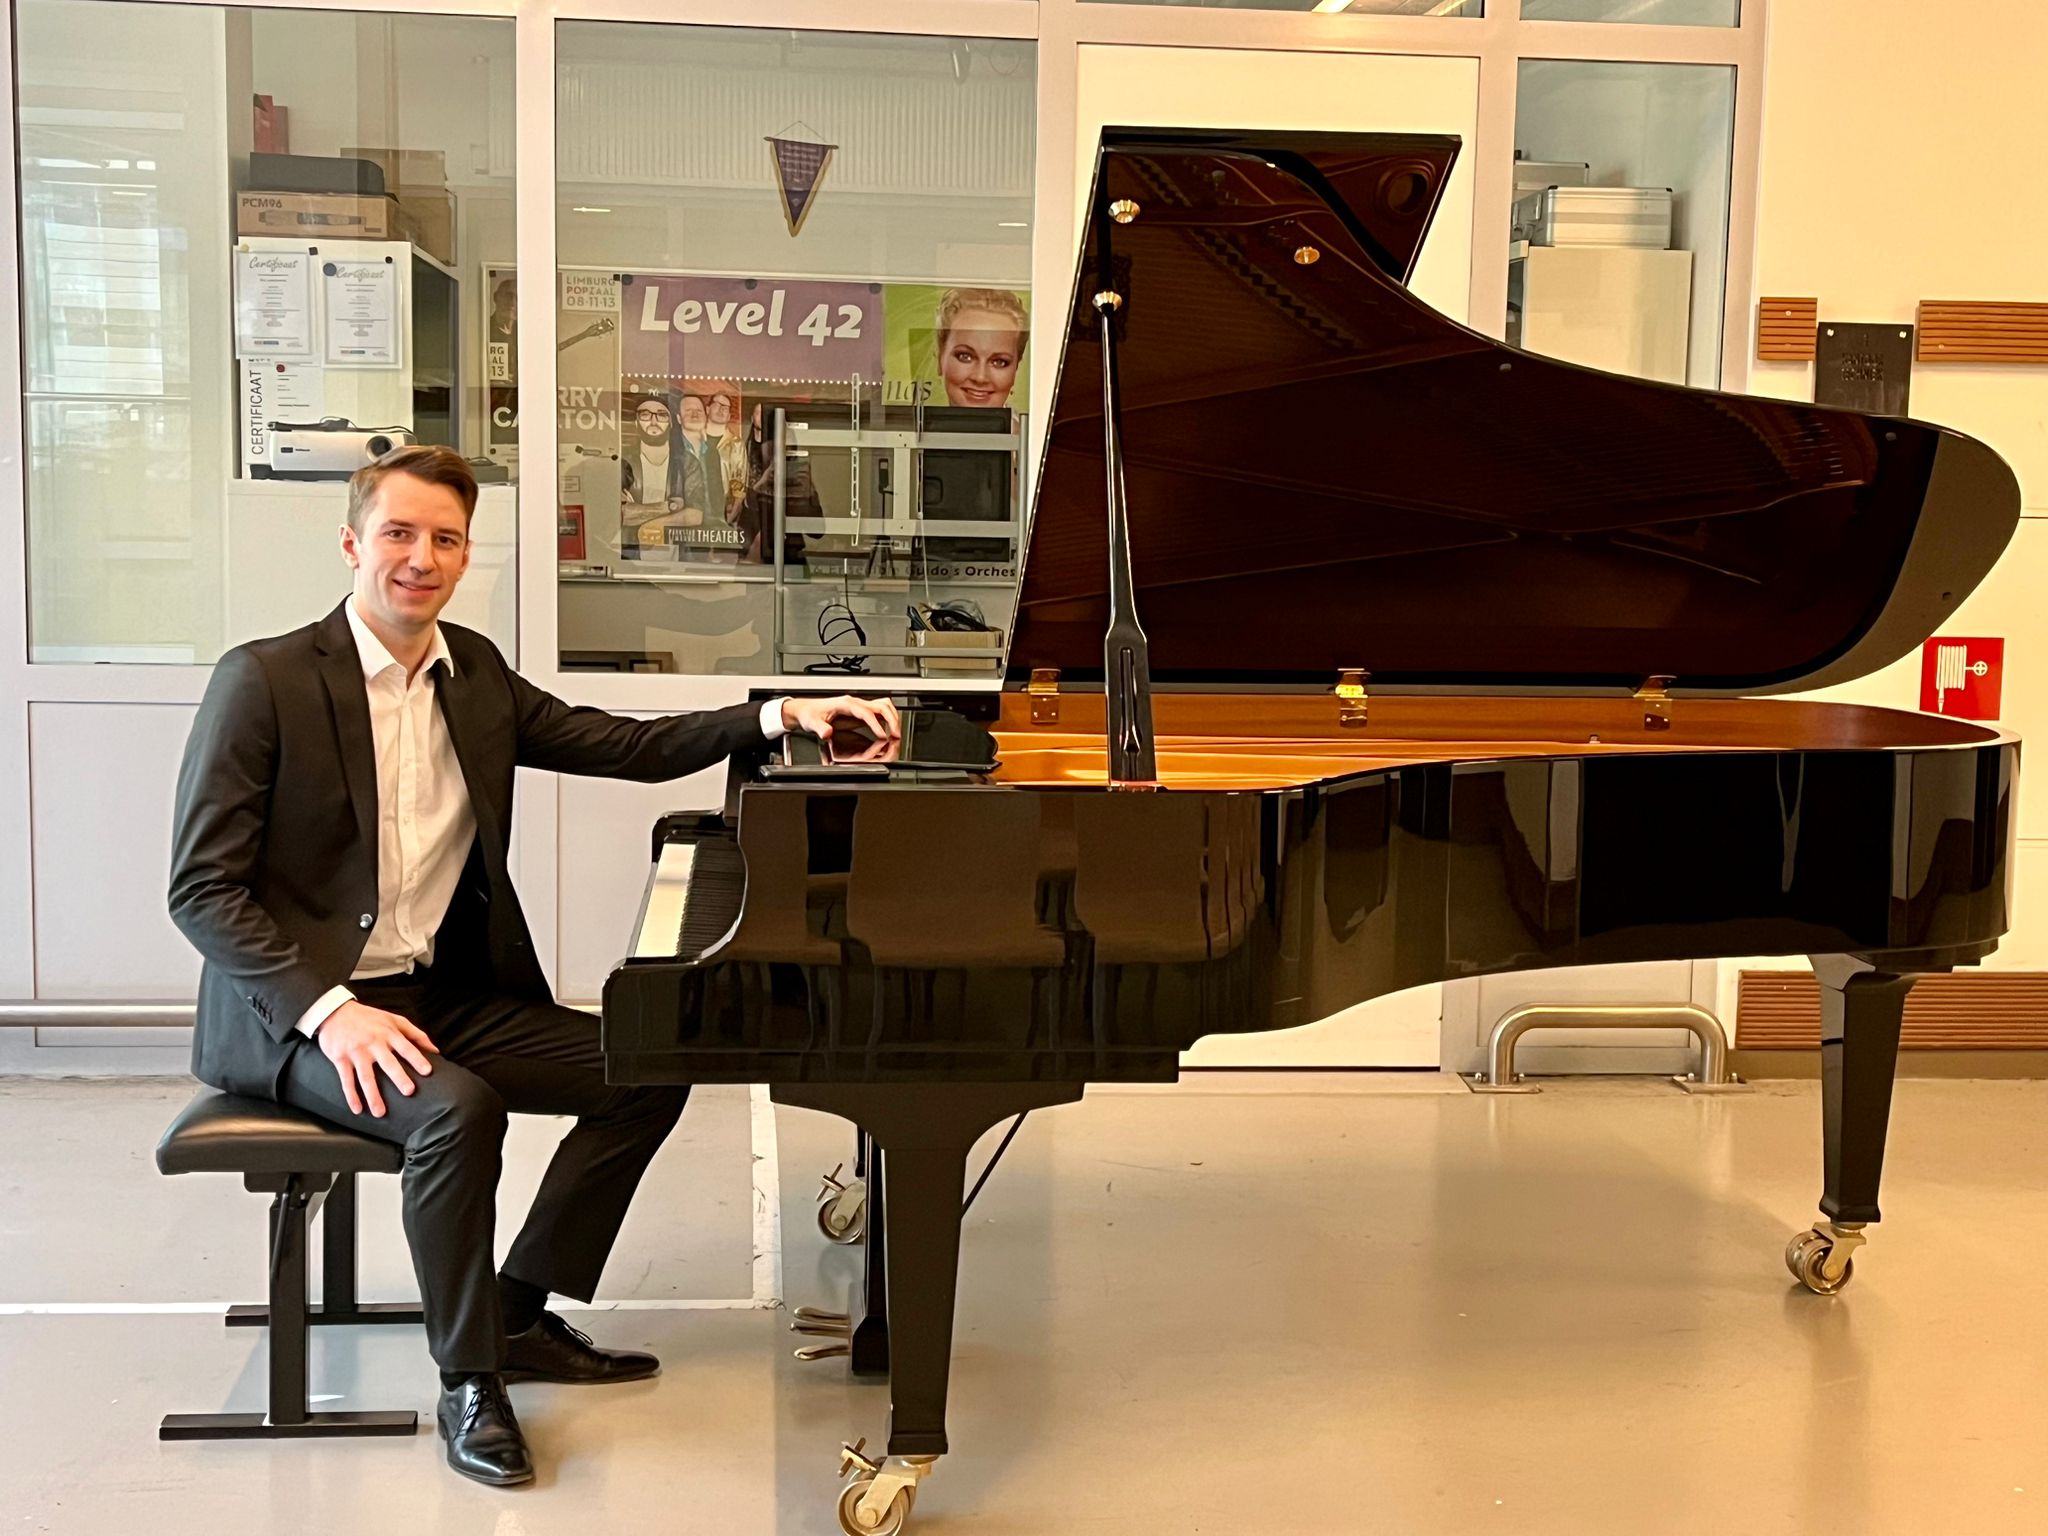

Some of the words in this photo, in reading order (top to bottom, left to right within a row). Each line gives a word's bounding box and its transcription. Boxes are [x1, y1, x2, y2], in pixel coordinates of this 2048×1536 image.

[242, 197, 283, 209] PCM96
[566, 276, 616, 286] LIMBURG
[640, 286, 786, 337] Level
[798, 303, 863, 347] 42
[249, 370, 264, 455] CERTIFICAAT
[697, 529, 745, 544] THEATERS
